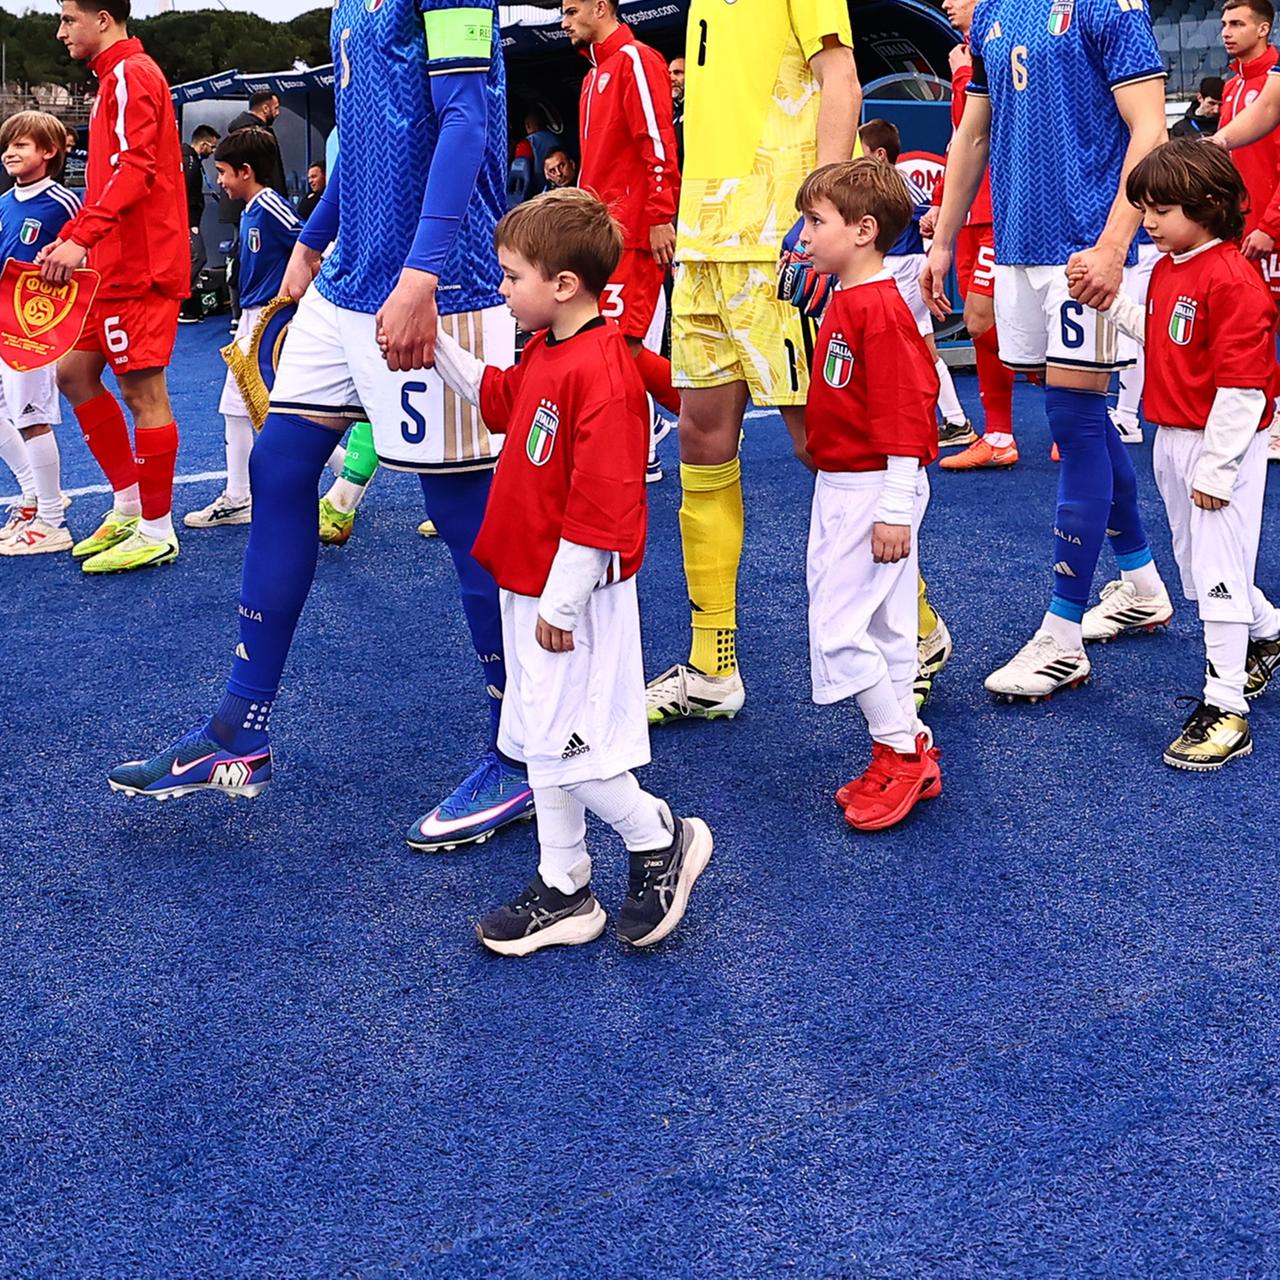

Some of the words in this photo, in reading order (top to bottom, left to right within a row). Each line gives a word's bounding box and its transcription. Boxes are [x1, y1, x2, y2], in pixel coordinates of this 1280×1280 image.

[698, 19, 707, 66] 1
[1011, 45, 1028, 91] 6
[974, 245, 995, 279] 5
[104, 316, 129, 353] 6
[1060, 300, 1085, 349] 6
[784, 338, 798, 391] 1
[401, 381, 427, 444] 5
[1208, 591, 1232, 600] adidas
[561, 744, 591, 760] adidas
